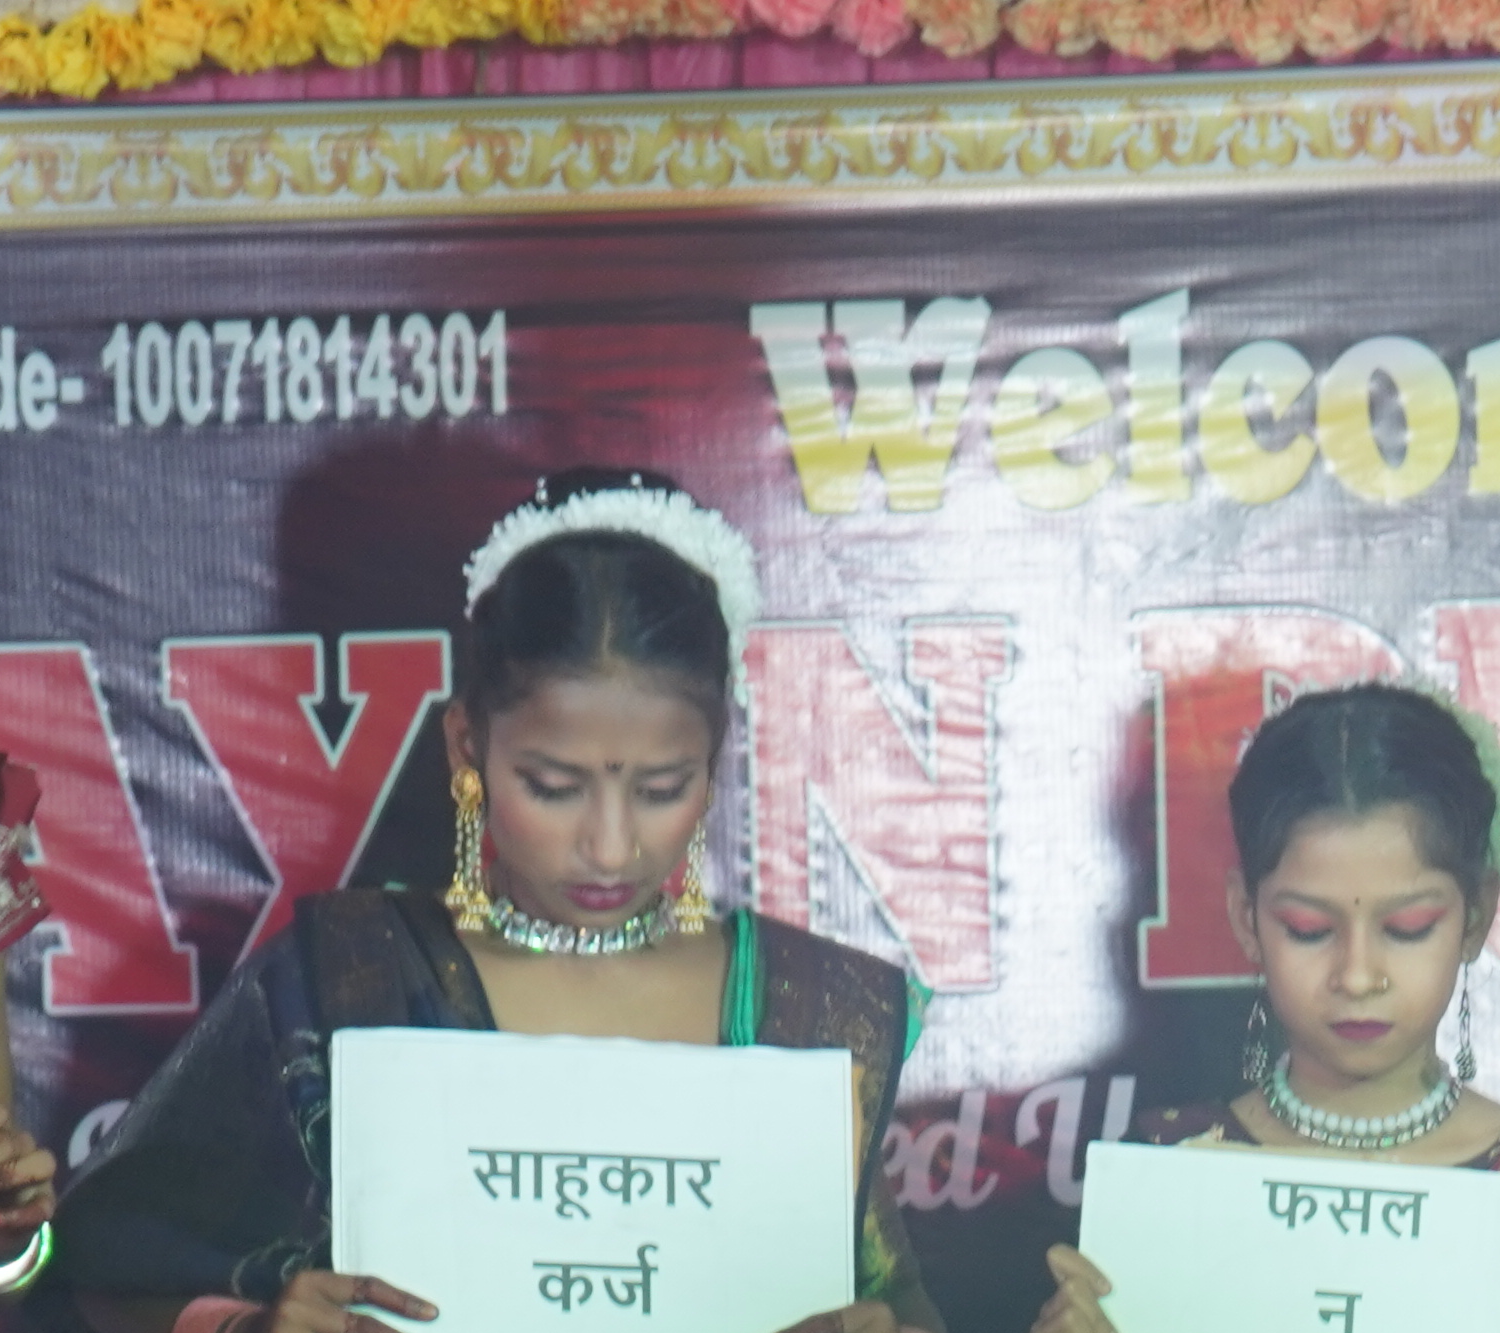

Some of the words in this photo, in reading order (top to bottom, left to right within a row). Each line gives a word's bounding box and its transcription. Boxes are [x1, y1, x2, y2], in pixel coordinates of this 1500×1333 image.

[102, 309, 508, 428] 10071814301
[468, 1148, 721, 1220] साहूकार
[1262, 1177, 1429, 1240] फसल
[533, 1245, 659, 1314] कर्ज
